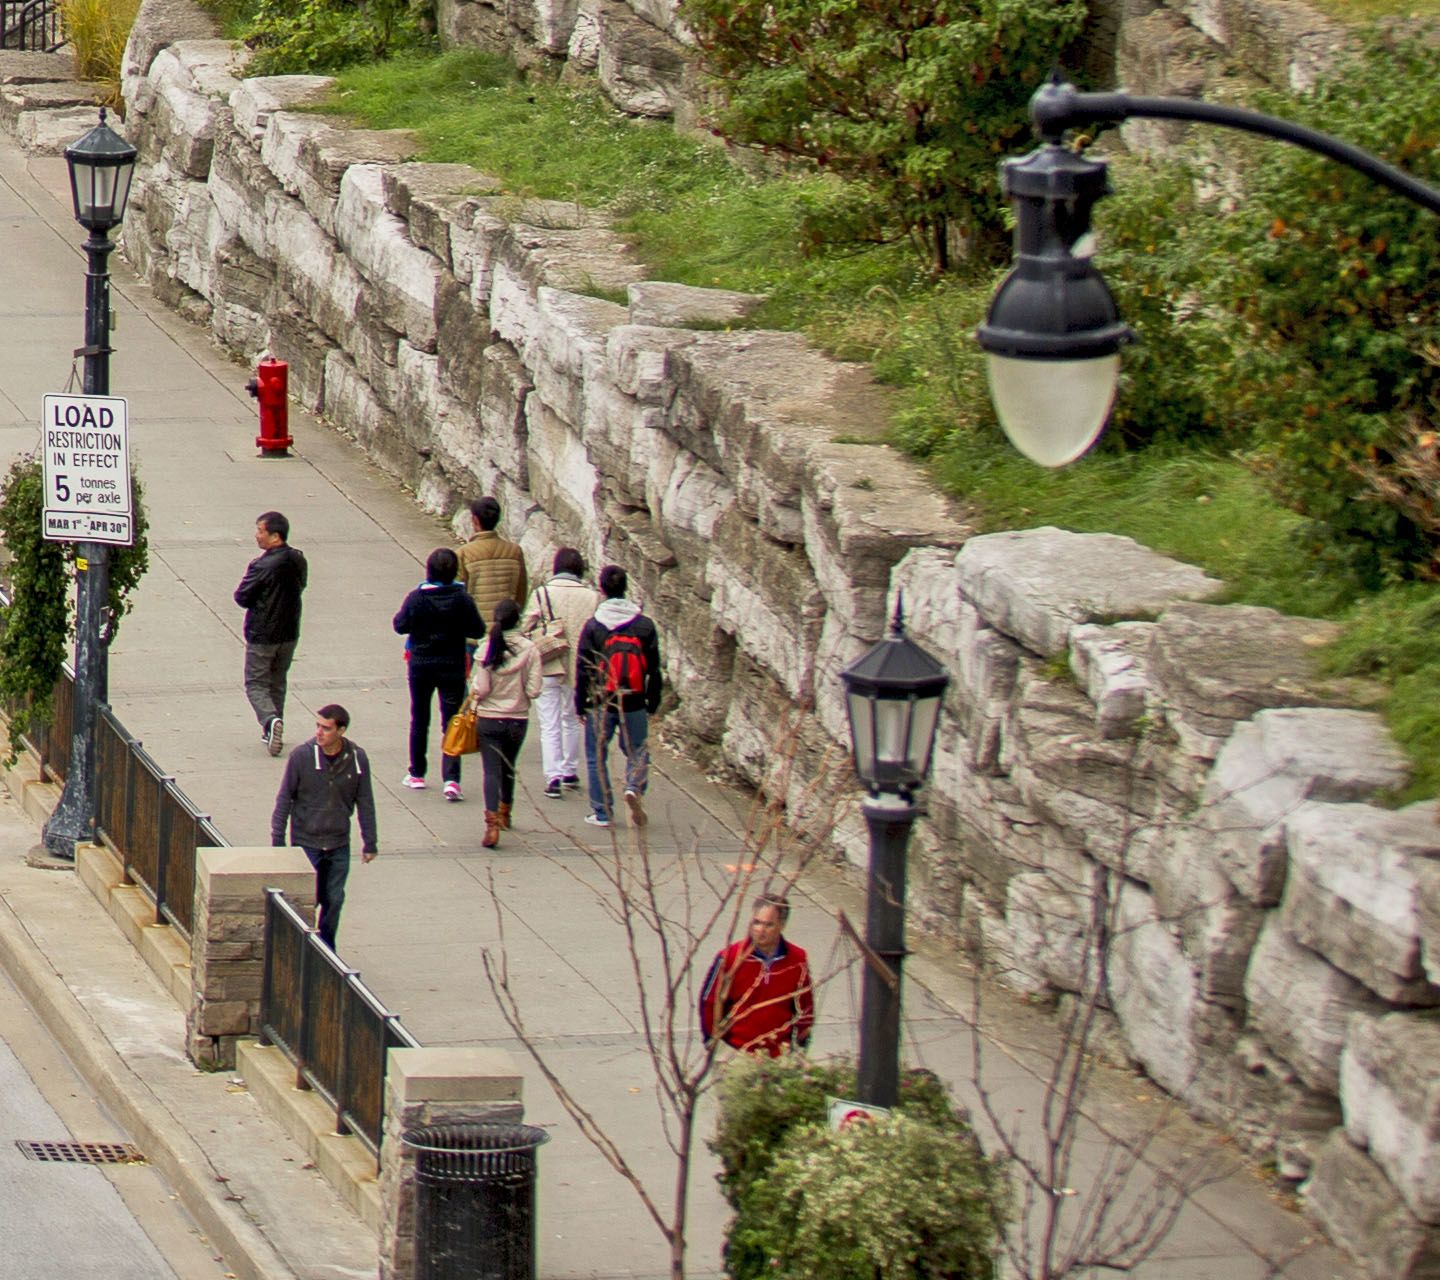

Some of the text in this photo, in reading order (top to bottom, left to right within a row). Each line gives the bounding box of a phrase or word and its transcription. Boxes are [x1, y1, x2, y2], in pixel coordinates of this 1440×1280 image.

[54, 404, 114, 429] LOAD
[48, 431, 121, 451] RESTRICTION
[53, 452, 119, 469] IN EFFECT
[55, 474, 116, 502] 5 tonnes
[76, 491, 121, 505] per axle
[48, 518, 69, 530] MAR
[90, 520, 108, 532] APR
